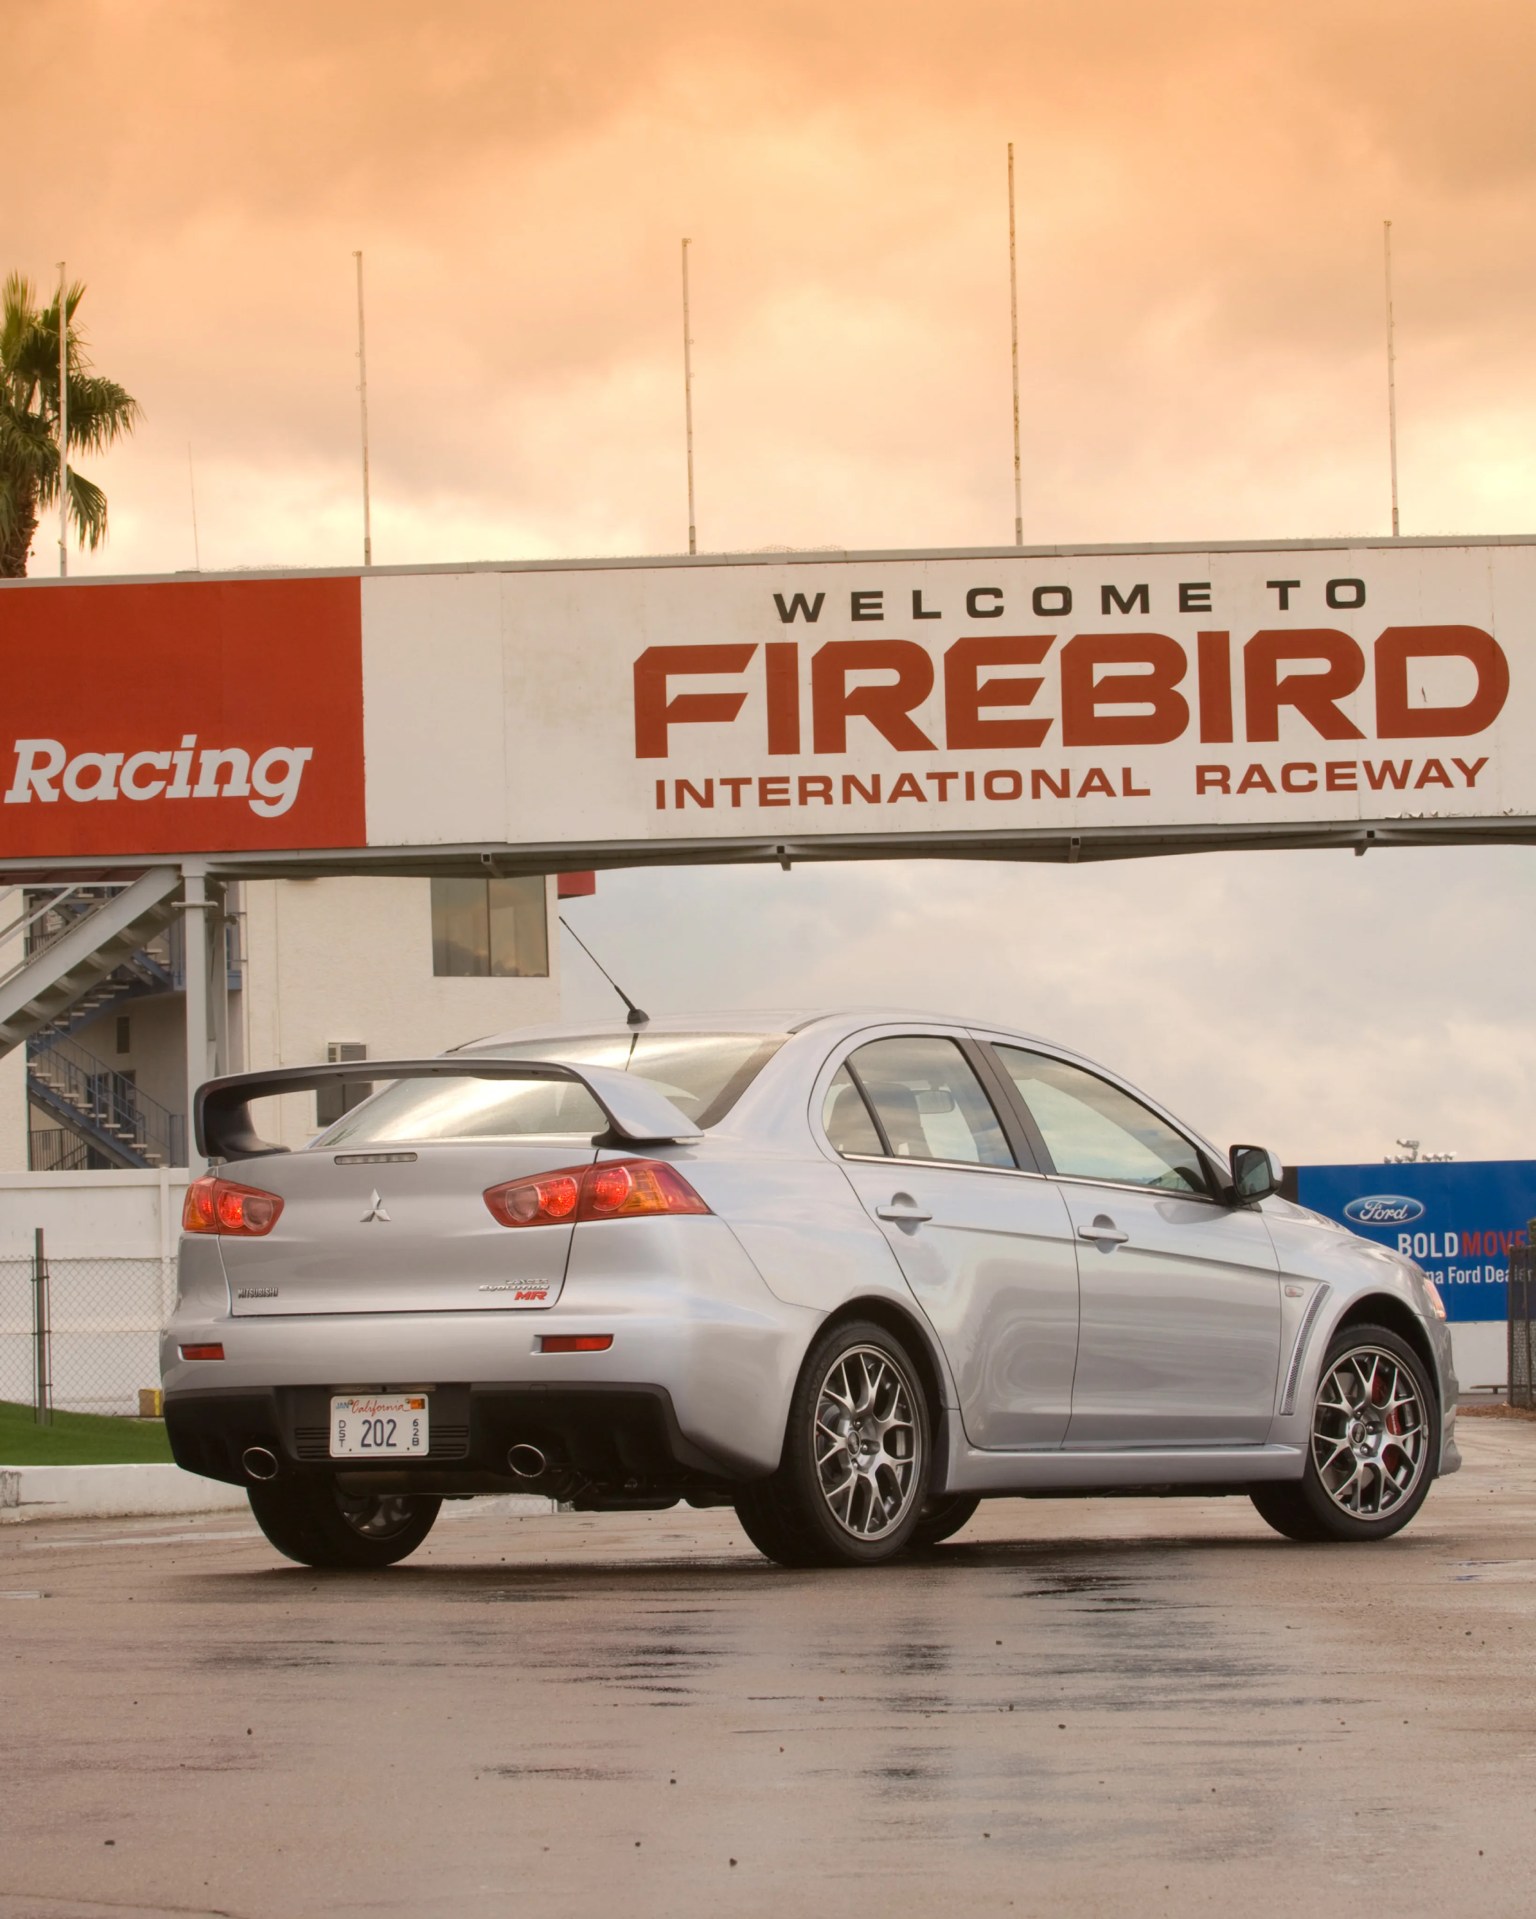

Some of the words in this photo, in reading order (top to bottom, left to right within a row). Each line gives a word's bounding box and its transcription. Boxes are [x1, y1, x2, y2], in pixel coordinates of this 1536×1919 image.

[773, 582, 1212, 623] WELCOME
[1266, 578, 1366, 610] TO
[633, 624, 1510, 758] FIREBIRD
[5, 734, 313, 818] Racing
[656, 767, 1151, 810] INTERNATIONAL
[1196, 757, 1490, 795] RACEWAY
[1360, 1199, 1409, 1220] Ford
[1447, 1265, 1481, 1284] Ford
[237, 1287, 279, 1299] MITSUBISHI
[514, 1291, 548, 1301] MR
[352, 1399, 410, 1416] California
[361, 1419, 397, 1447] 202
